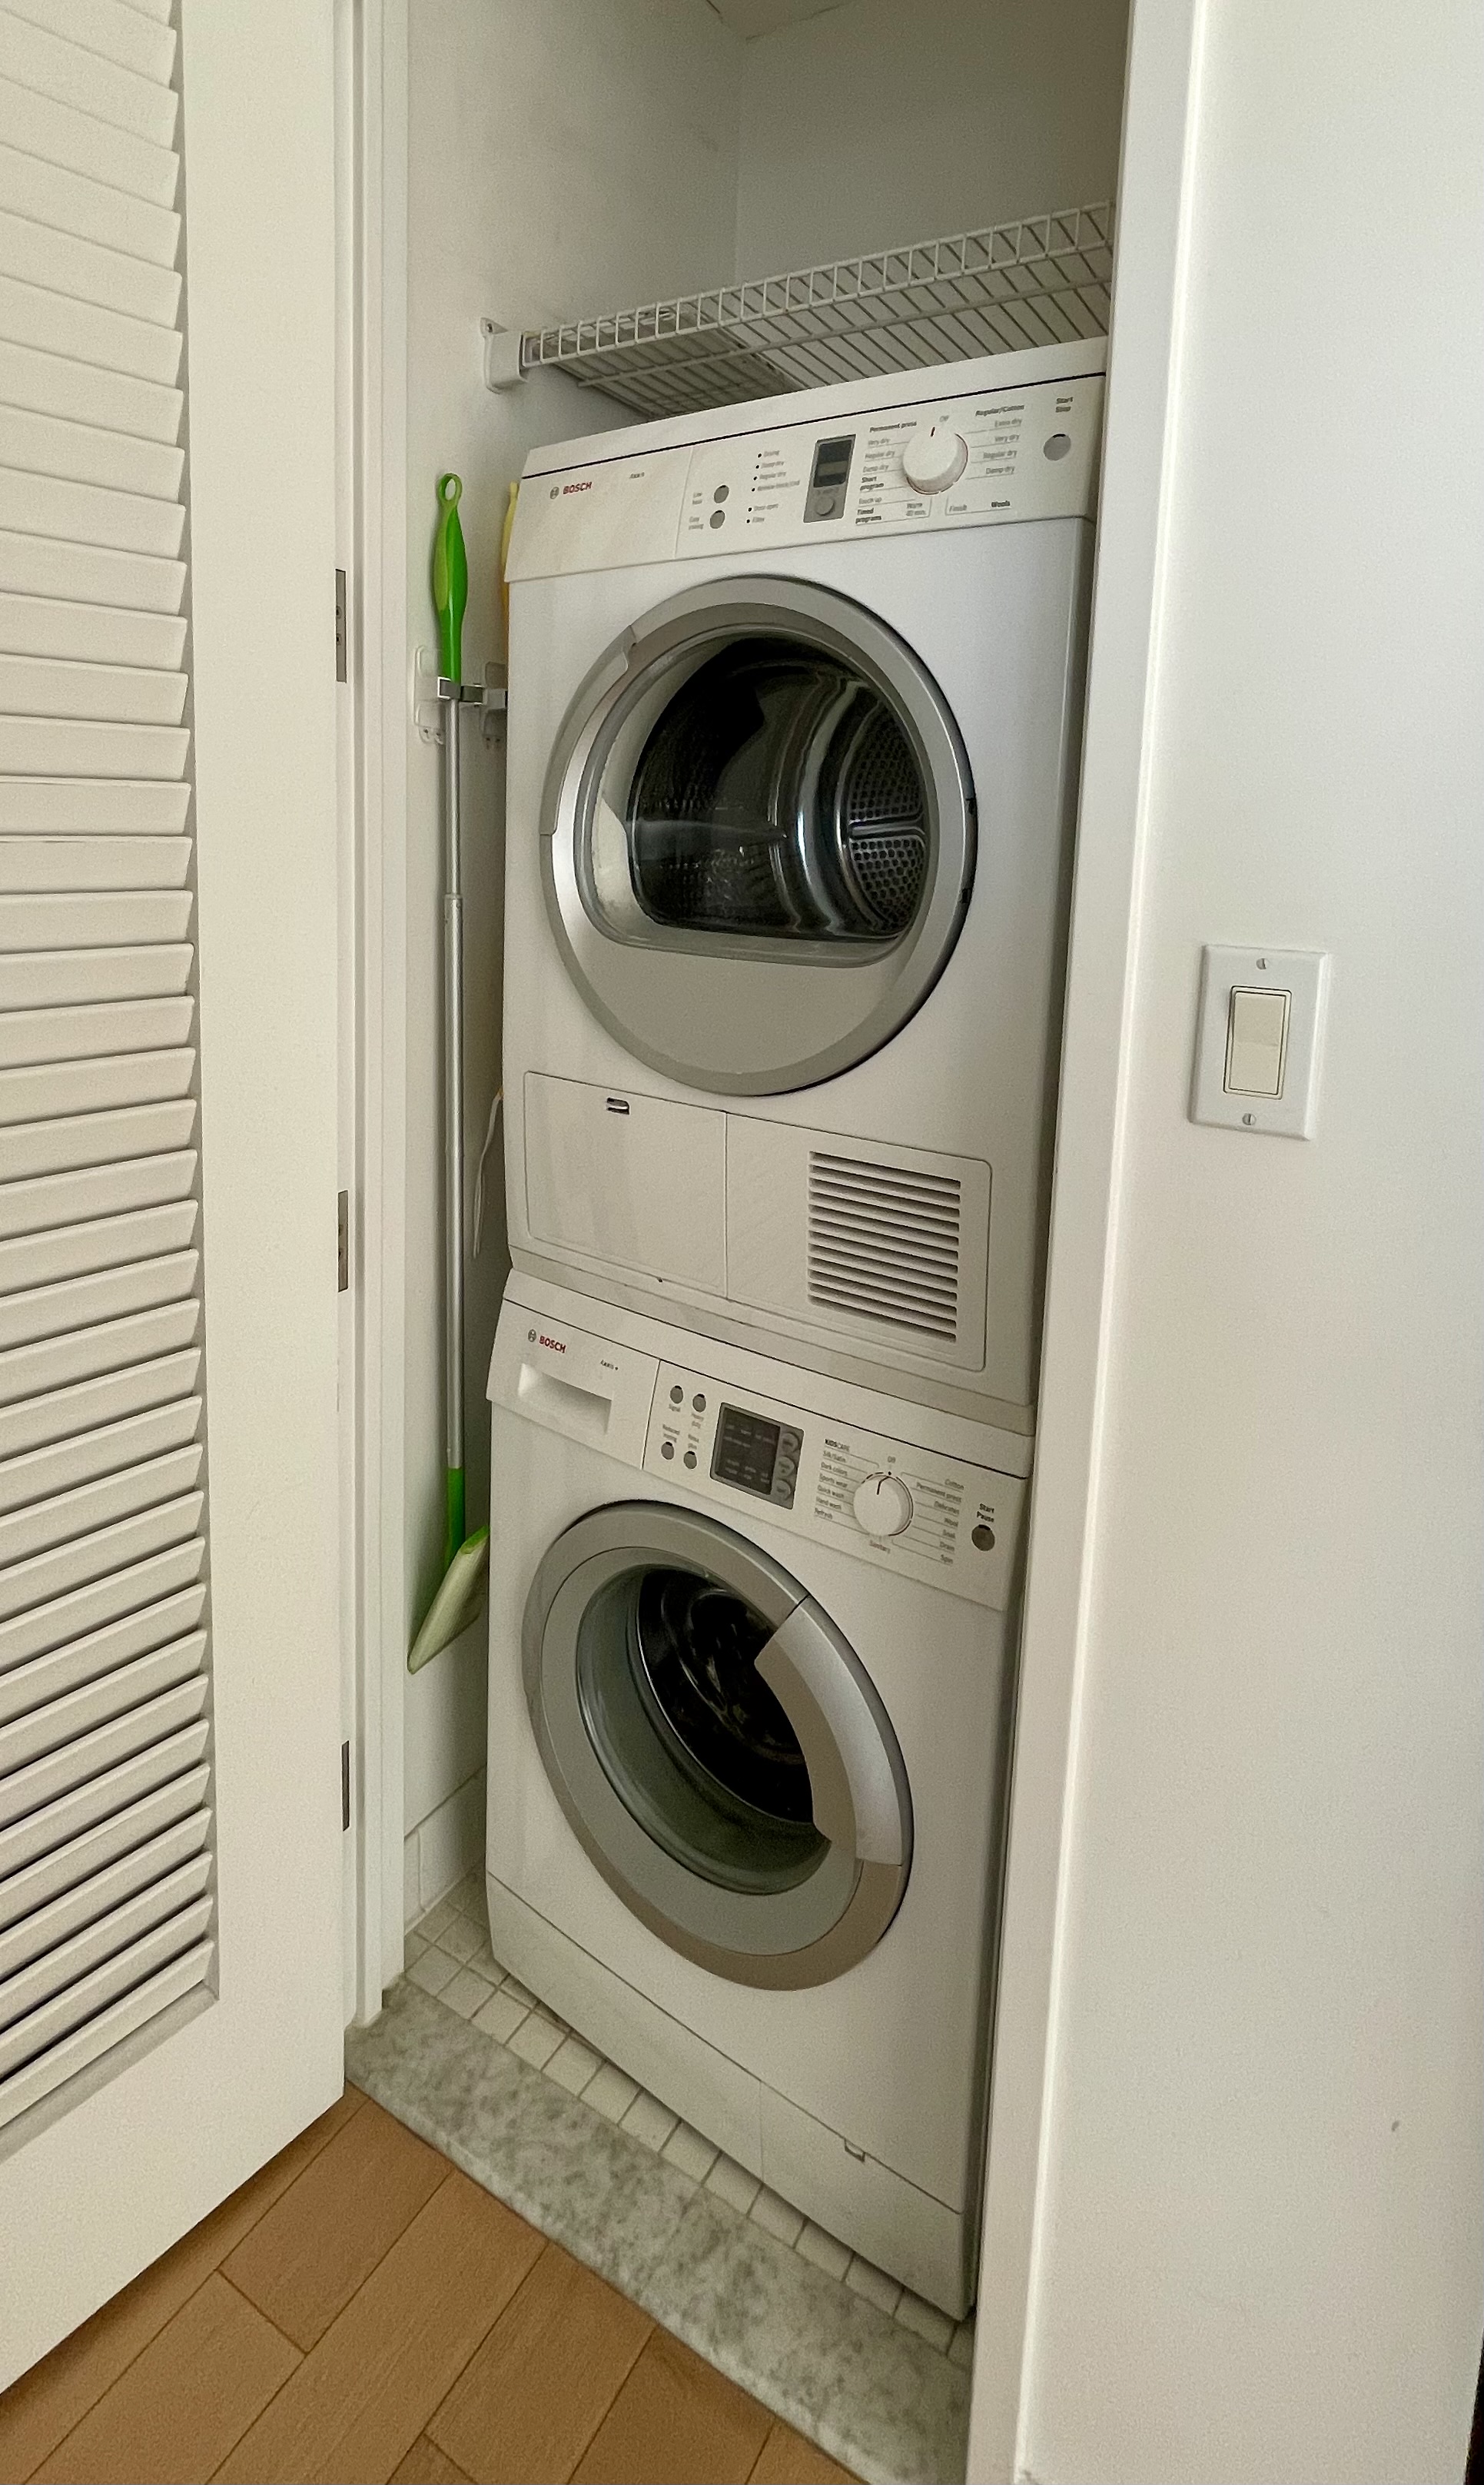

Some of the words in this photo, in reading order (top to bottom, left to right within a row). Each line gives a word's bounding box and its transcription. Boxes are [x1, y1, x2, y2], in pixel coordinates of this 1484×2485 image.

[563, 482, 592, 494] BOSCH
[539, 1335, 566, 1354] BOSCH
[979, 1503, 994, 1513] Start
[977, 1511, 994, 1523] Pause
